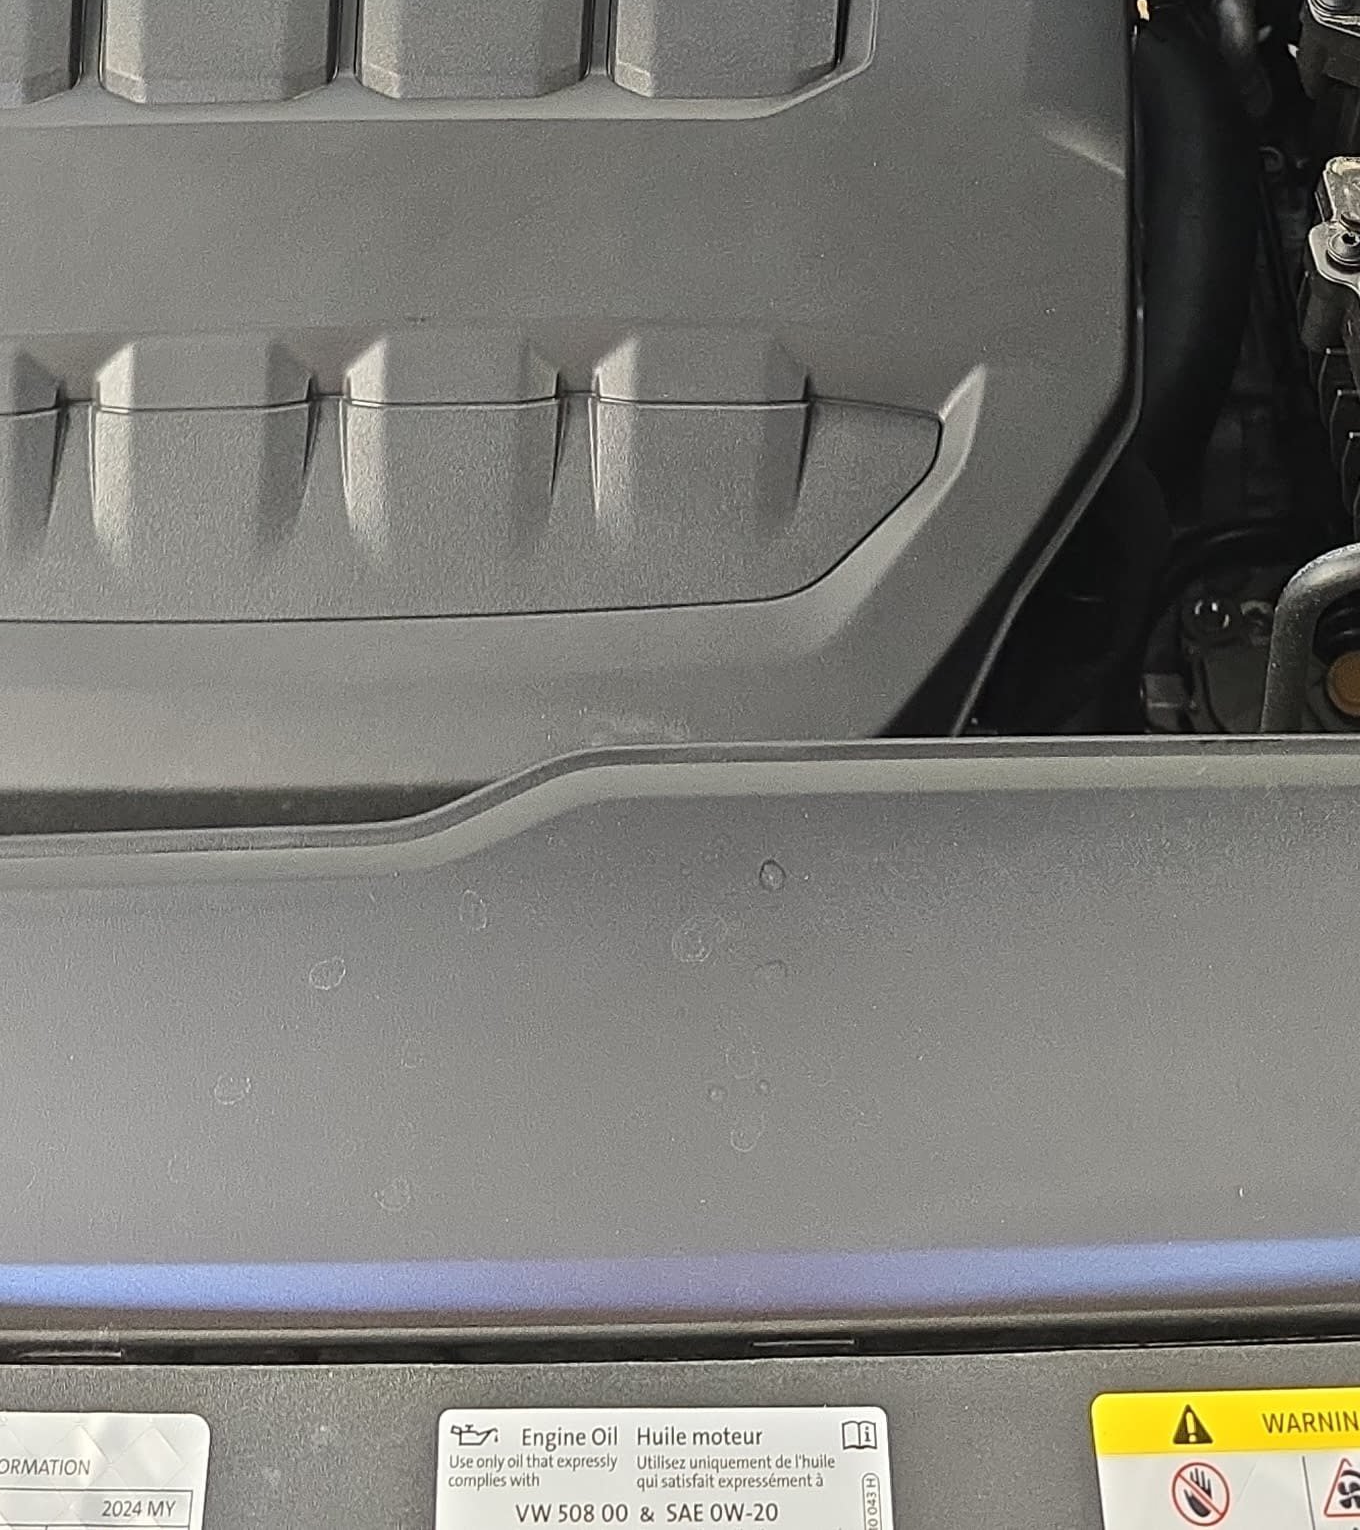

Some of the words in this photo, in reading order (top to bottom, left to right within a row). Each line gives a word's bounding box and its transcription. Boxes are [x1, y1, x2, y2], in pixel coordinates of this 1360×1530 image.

[521, 1428, 586, 1451] Engine
[591, 1427, 618, 1447] Oil
[637, 1427, 687, 1447] Huile
[692, 1429, 763, 1447] moteur
[449, 1454, 474, 1469] Use
[476, 1454, 505, 1472] only
[507, 1454, 523, 1469] oil
[526, 1454, 554, 1469] that
[556, 1454, 618, 1472] expressly
[637, 1455, 687, 1470] Utilisez
[689, 1456, 771, 1473] uniquement
[774, 1454, 792, 1469] de
[795, 1454, 836, 1469] l'huile
[448, 1474, 507, 1491] complies
[511, 1473, 540, 1488] with
[637, 1475, 658, 1491] qui
[661, 1473, 715, 1488] satisfait
[718, 1472, 812, 1490] expressément
[815, 1473, 824, 1488] à
[865, 1478, 876, 1488] H
[102, 1500, 142, 1518] 2024
[147, 1500, 176, 1518] MY
[515, 1504, 556, 1523] VW
[558, 1504, 599, 1523] 508
[603, 1504, 628, 1523] 00
[640, 1504, 654, 1523] &
[666, 1503, 703, 1523] SAE
[710, 1503, 778, 1523] 0W-20
[866, 1492, 878, 1515] 043
